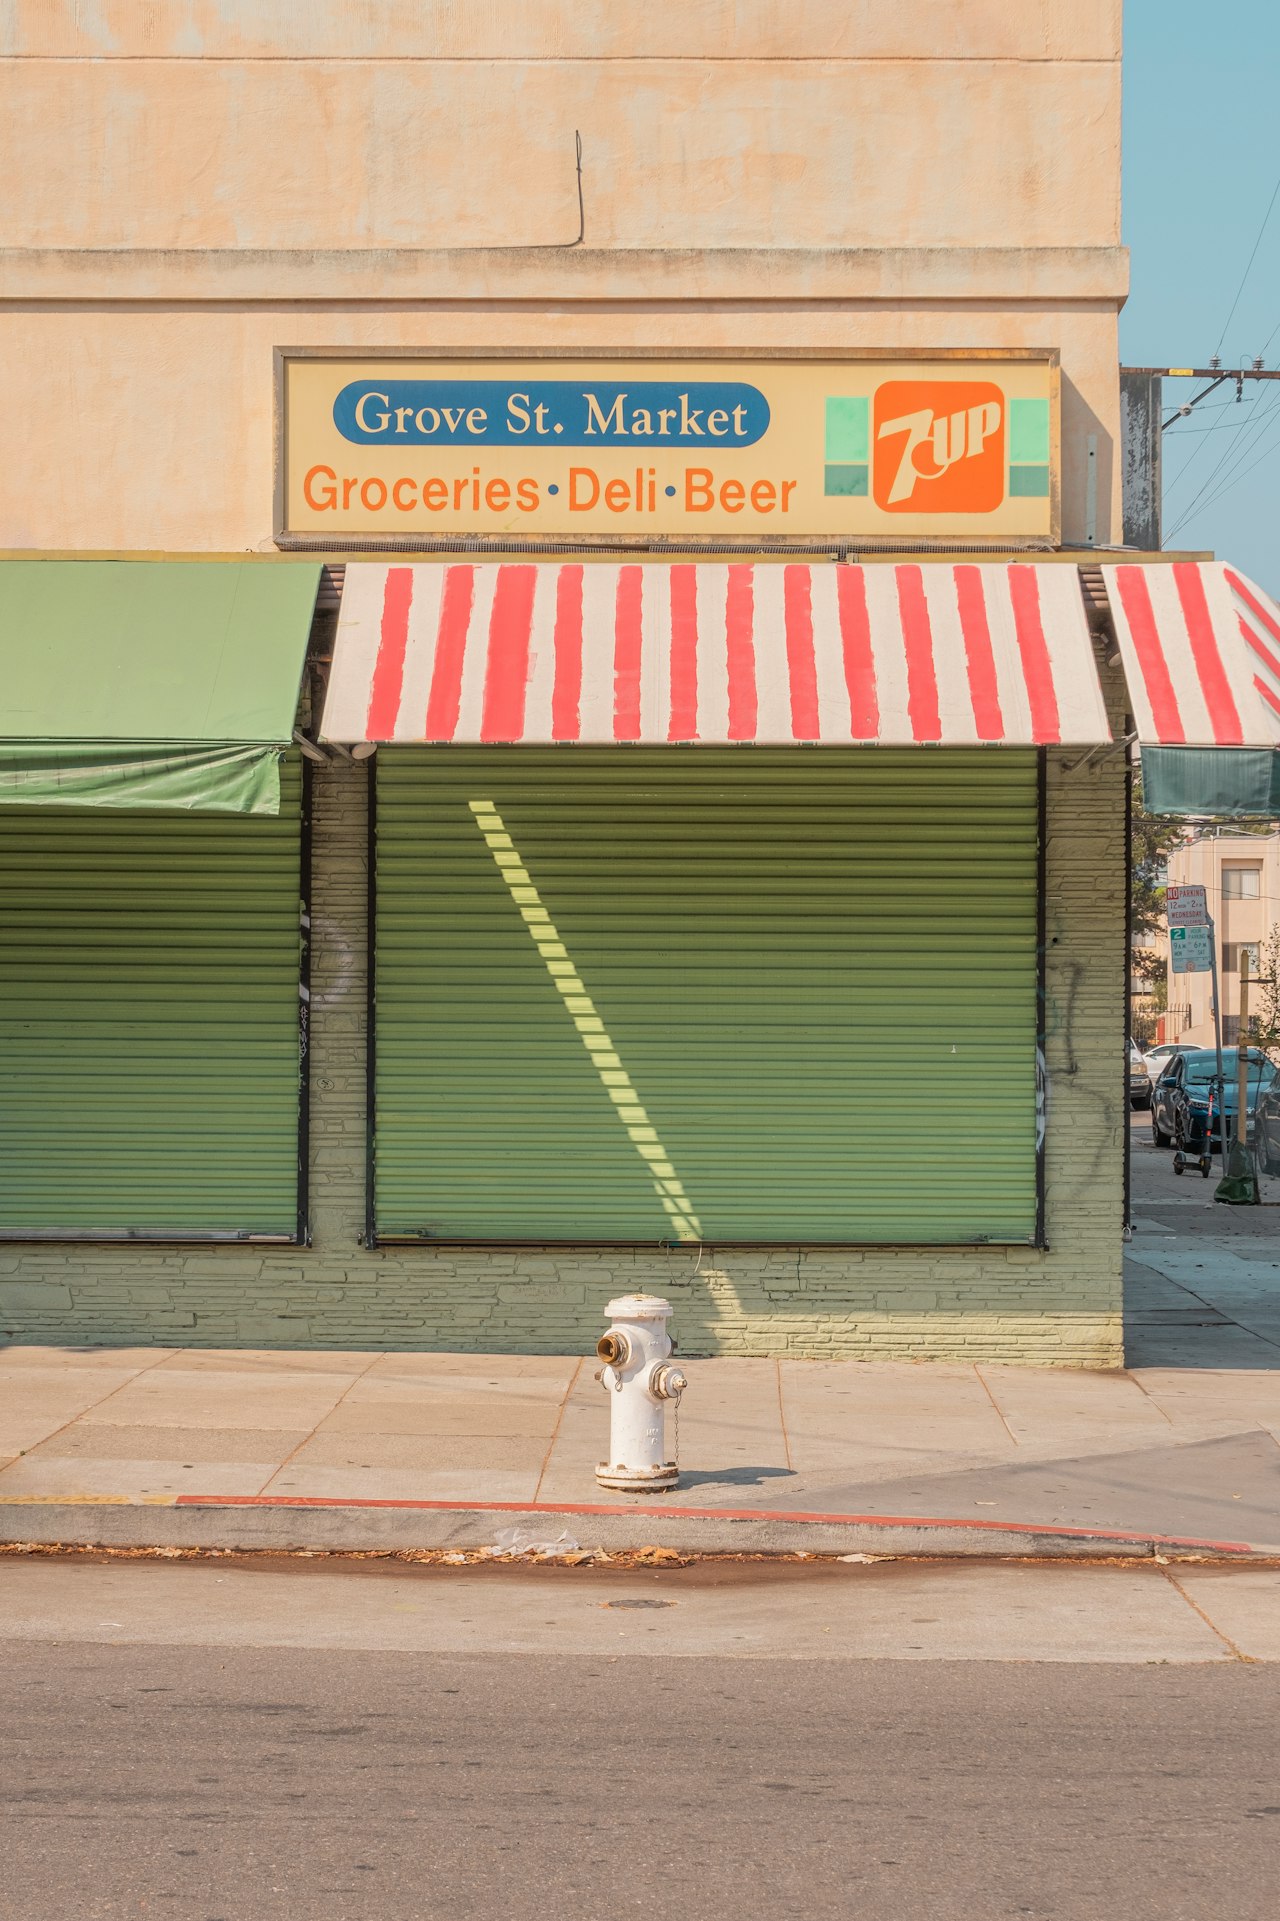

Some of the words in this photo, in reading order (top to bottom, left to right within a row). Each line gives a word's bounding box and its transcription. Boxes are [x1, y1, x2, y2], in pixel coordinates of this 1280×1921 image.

[354, 391, 488, 435] Grove
[506, 392, 564, 435] St.
[582, 392, 748, 437] Market
[877, 401, 1001, 505] 7UP
[303, 464, 541, 513] Groceries
[568, 466, 656, 513] Deli
[684, 467, 797, 514] Beer
[1167, 888, 1178, 899] NO
[1179, 888, 1204, 898] PARKING
[1173, 929, 1182, 939] 2
